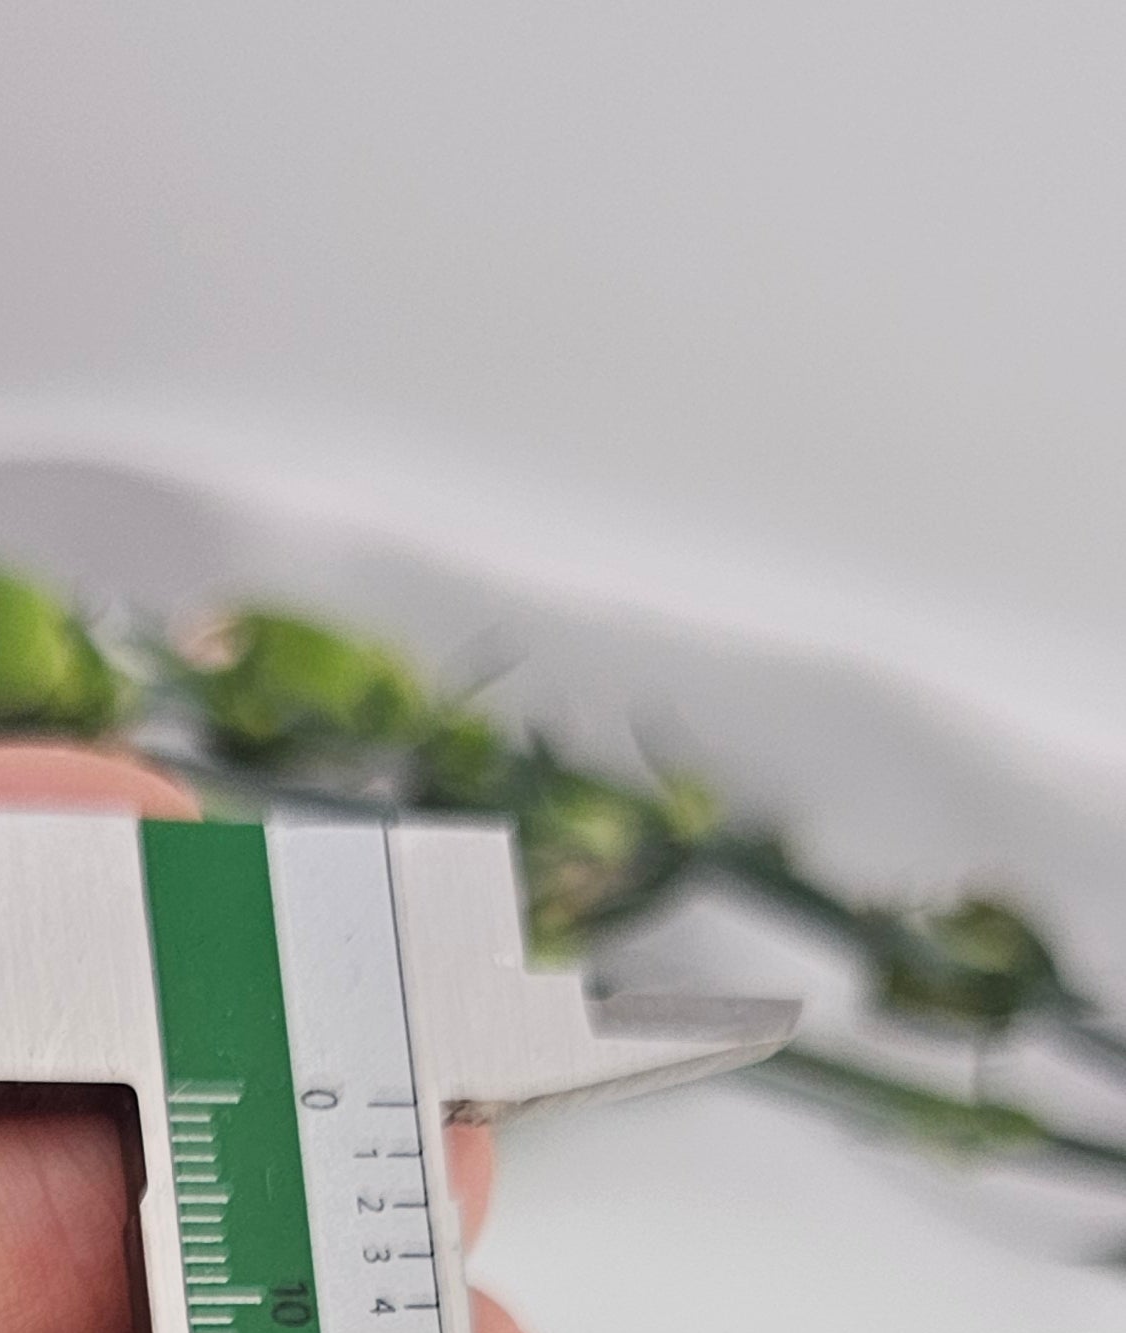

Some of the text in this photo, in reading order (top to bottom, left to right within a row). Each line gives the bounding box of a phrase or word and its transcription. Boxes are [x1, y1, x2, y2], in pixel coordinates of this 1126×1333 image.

[300, 1090, 338, 1111] 0
[354, 1149, 378, 1159] 1
[357, 1197, 384, 1215] 2
[363, 1248, 391, 1263] 3
[269, 1282, 311, 1328] 10
[369, 1298, 396, 1315] 4
